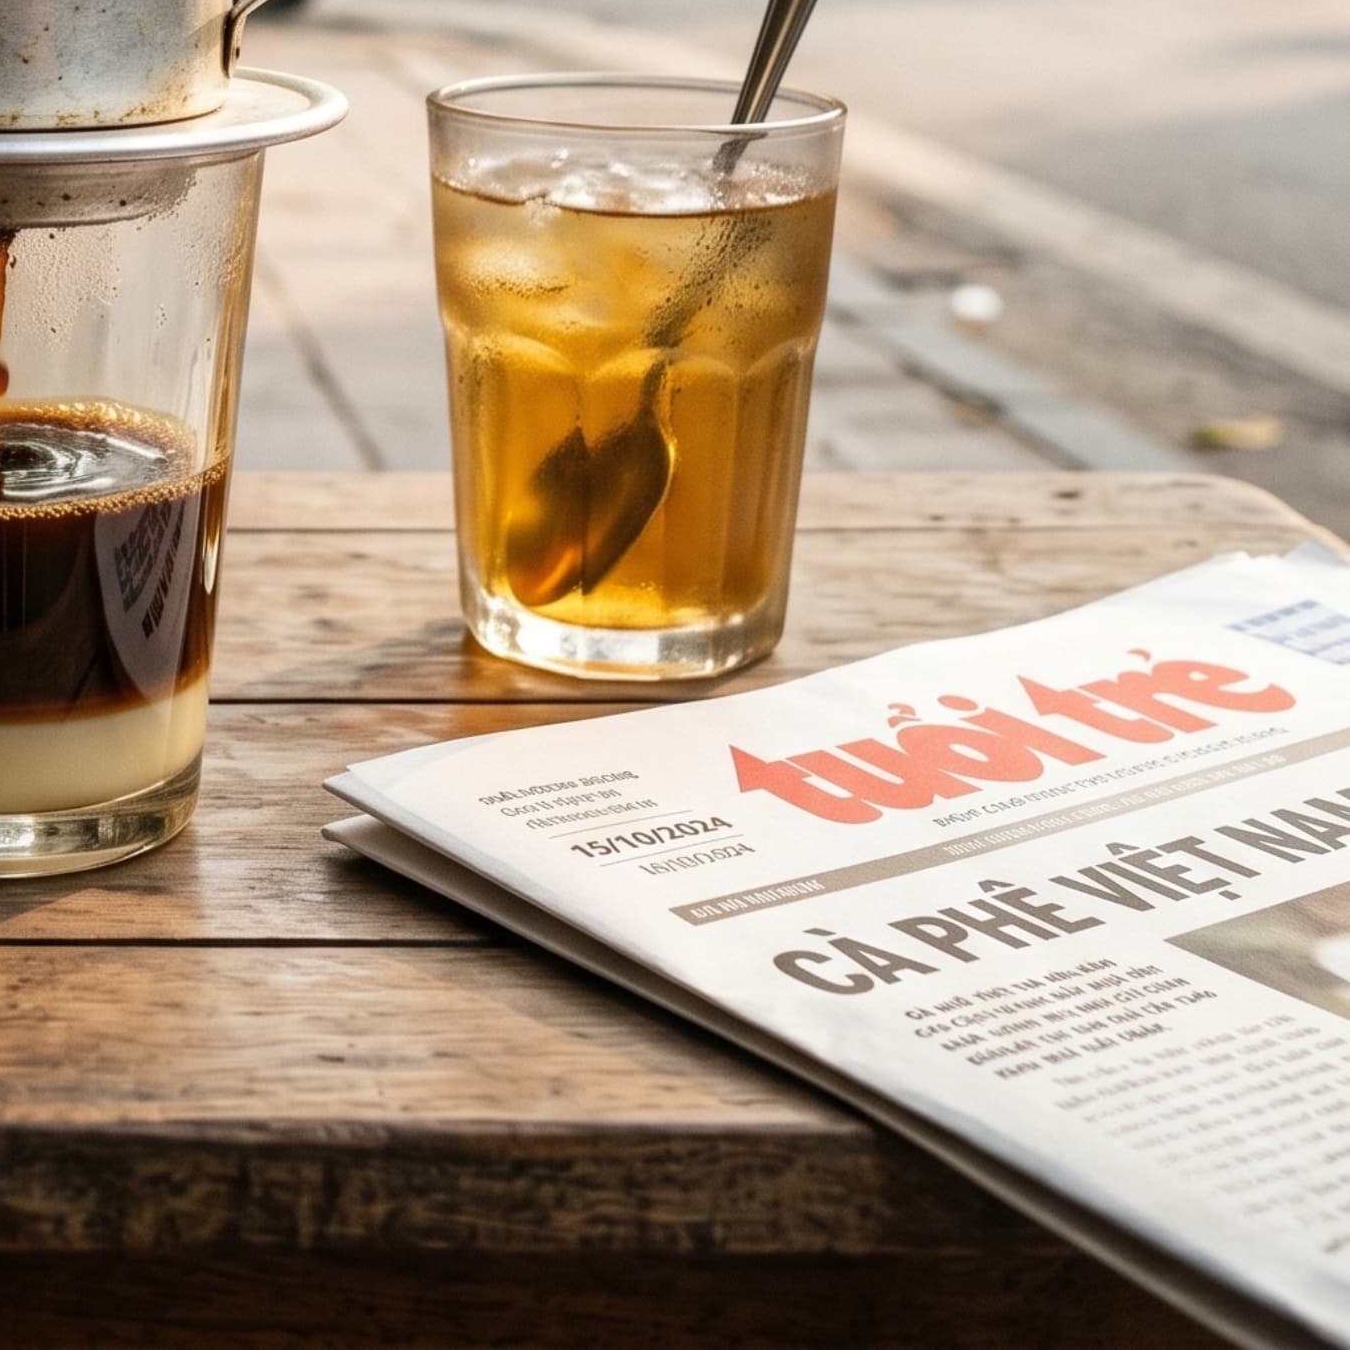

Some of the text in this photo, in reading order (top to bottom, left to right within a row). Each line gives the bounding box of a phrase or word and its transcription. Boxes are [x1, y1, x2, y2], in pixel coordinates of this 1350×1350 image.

[570, 816, 733, 858] 15/10/2024
[773, 928, 941, 995] CÀ
[888, 879, 1106, 962] PHÊ
[1049, 836, 1261, 912] VIỆT
